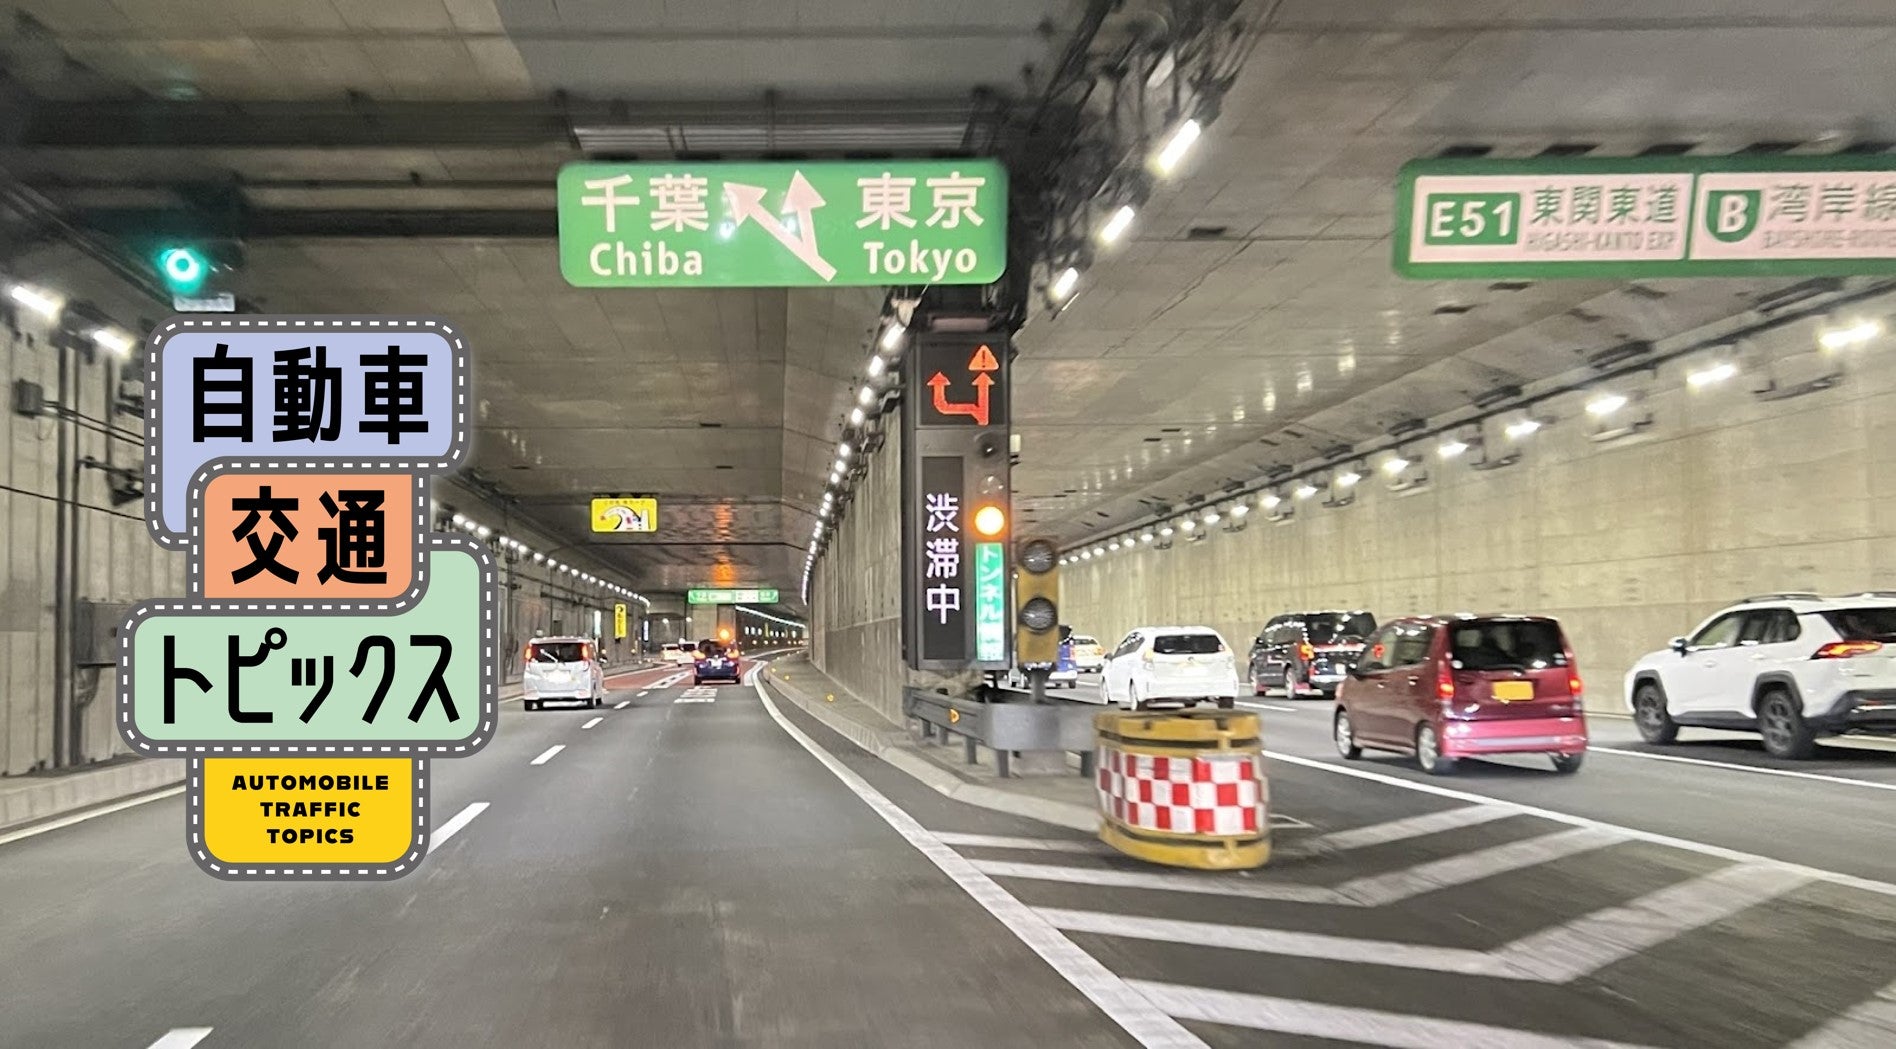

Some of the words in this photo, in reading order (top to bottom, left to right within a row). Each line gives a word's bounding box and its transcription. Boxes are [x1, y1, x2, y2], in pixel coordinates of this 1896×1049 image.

[581, 174, 709, 232] 千葉
[855, 171, 986, 230] 東京
[1429, 200, 1513, 238] E51
[1529, 185, 1679, 226] 東関東道
[1716, 193, 1749, 233] B
[589, 241, 703, 276] Chiba
[863, 239, 978, 283] Tokyo
[925, 492, 961, 625] 渋滞中
